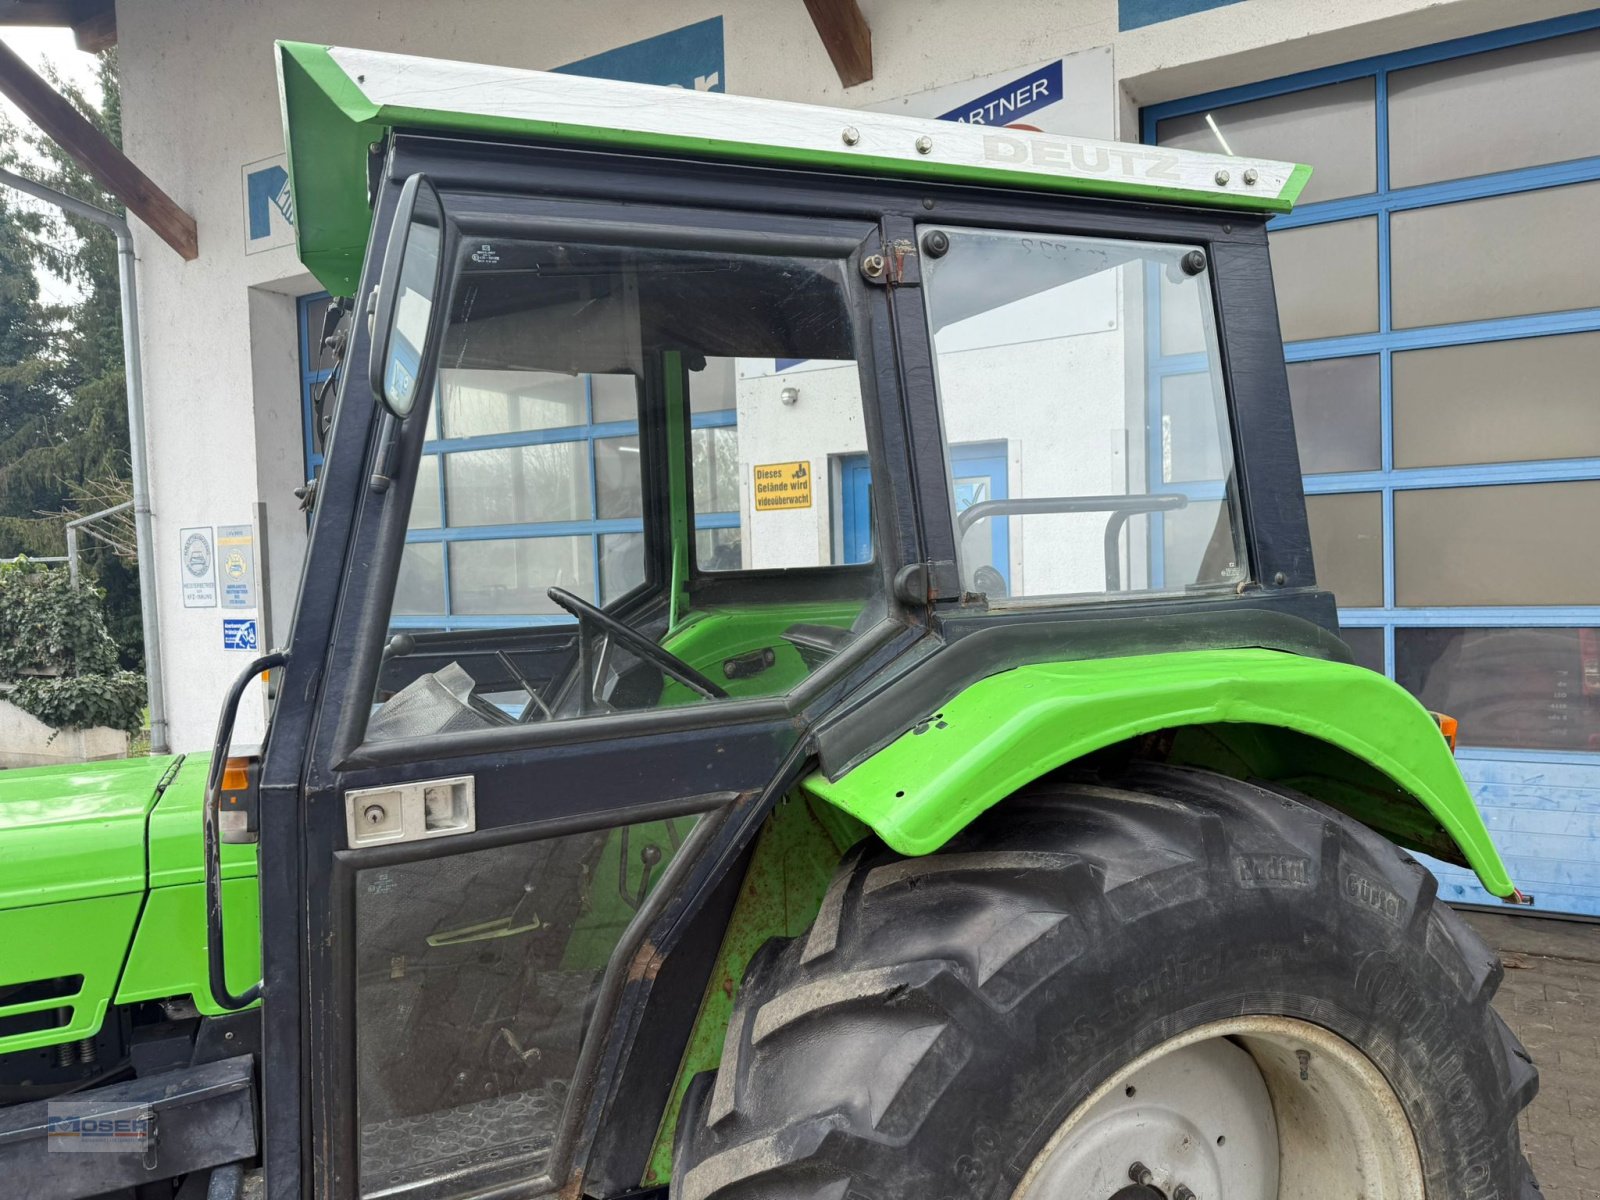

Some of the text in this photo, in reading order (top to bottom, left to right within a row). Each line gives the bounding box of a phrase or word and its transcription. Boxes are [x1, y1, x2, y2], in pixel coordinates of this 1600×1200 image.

[956, 79, 1050, 126] RTNER
[982, 134, 1181, 181] DEUTZ
[756, 470, 782, 480] Dieses
[757, 480, 808, 493] Gelände wird
[757, 494, 809, 507] videoüberwacht
